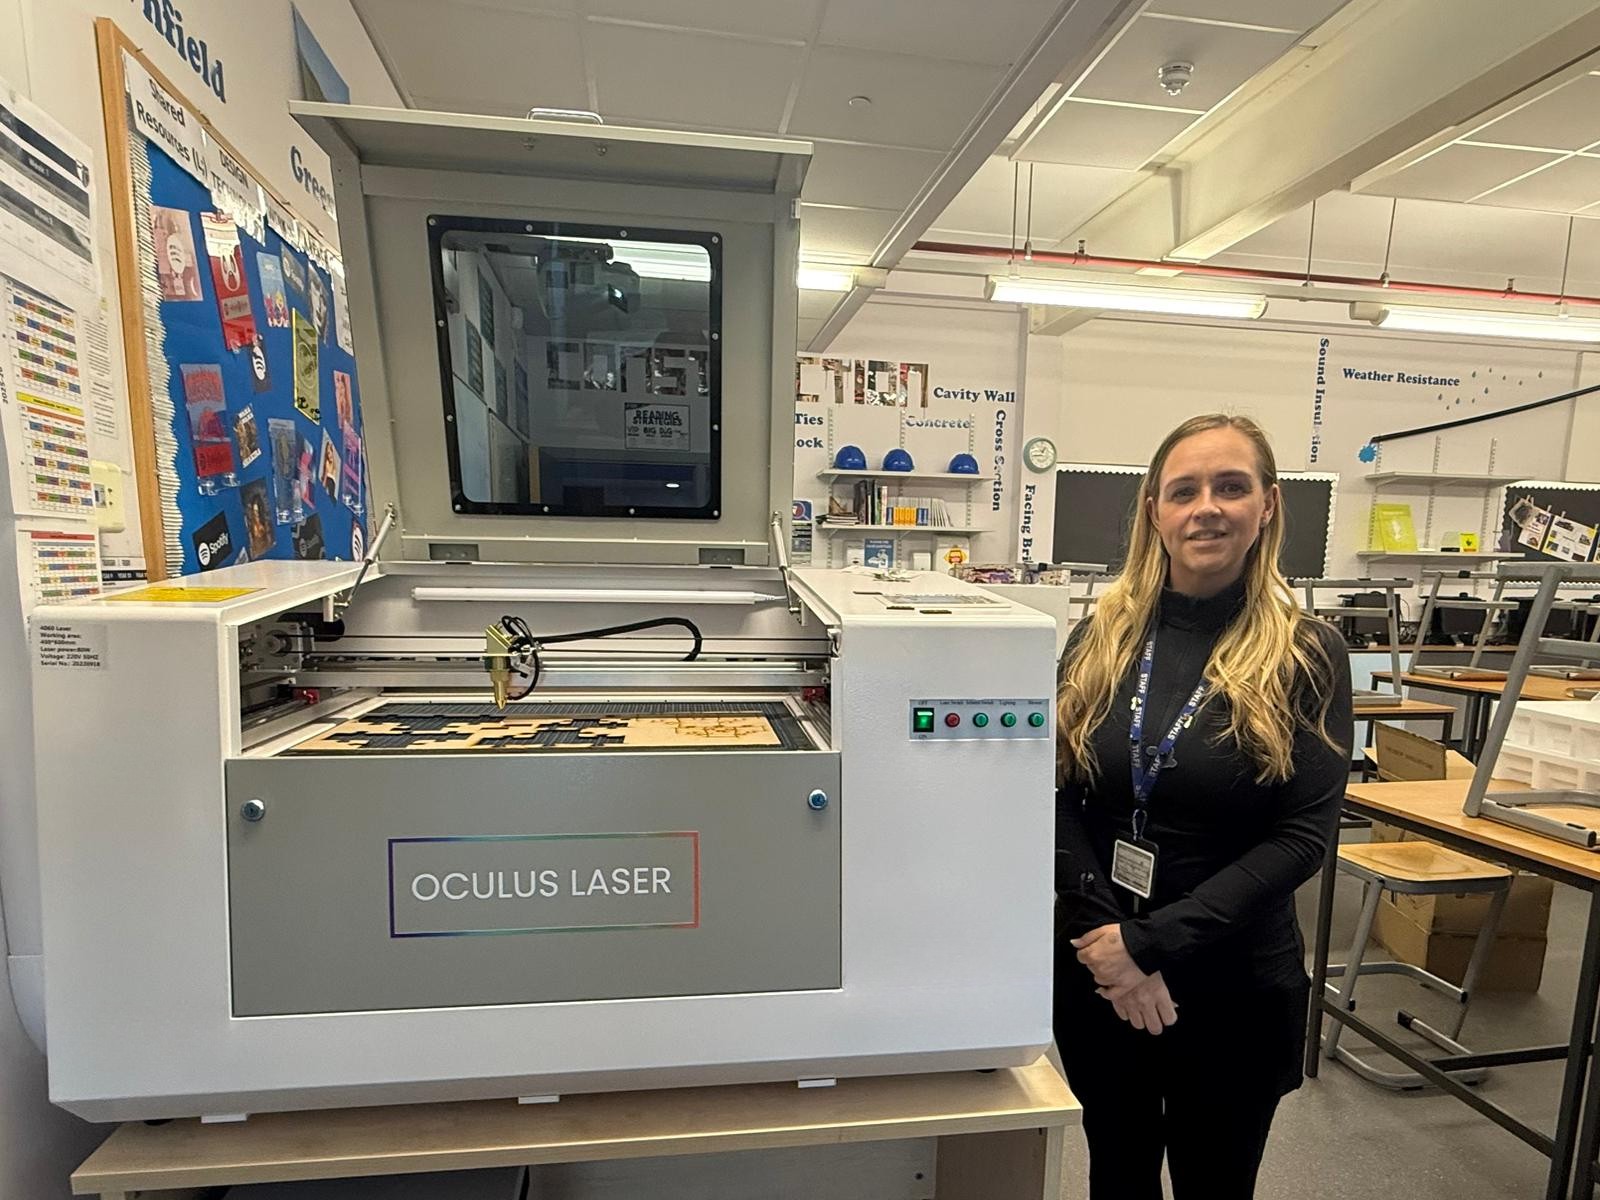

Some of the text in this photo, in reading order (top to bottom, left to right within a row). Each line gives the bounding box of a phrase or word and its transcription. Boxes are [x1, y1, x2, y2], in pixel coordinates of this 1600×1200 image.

[143, 0, 226, 103] nfield
[149, 79, 185, 127] Shared
[136, 100, 190, 162] Resources
[1342, 367, 1460, 387] Weather Resistance
[933, 387, 1015, 403] Cavity Wall
[1310, 338, 1329, 463] Sound Insultion
[632, 417, 682, 426] STRATEGIES
[635, 410, 679, 420] READING
[795, 413, 823, 425] Ties
[905, 416, 970, 429] Concrete
[796, 436, 823, 448] ock
[995, 410, 1006, 451] Cross
[1021, 484, 1036, 563] Facing Bri
[209, 532, 229, 555] Spotify
[1144, 640, 1154, 661] STAFF
[1138, 672, 1148, 694] STAFF
[1188, 685, 1205, 708] STAFF
[1132, 706, 1143, 729] STAFF
[411, 867, 672, 900] OCULUS LASER
